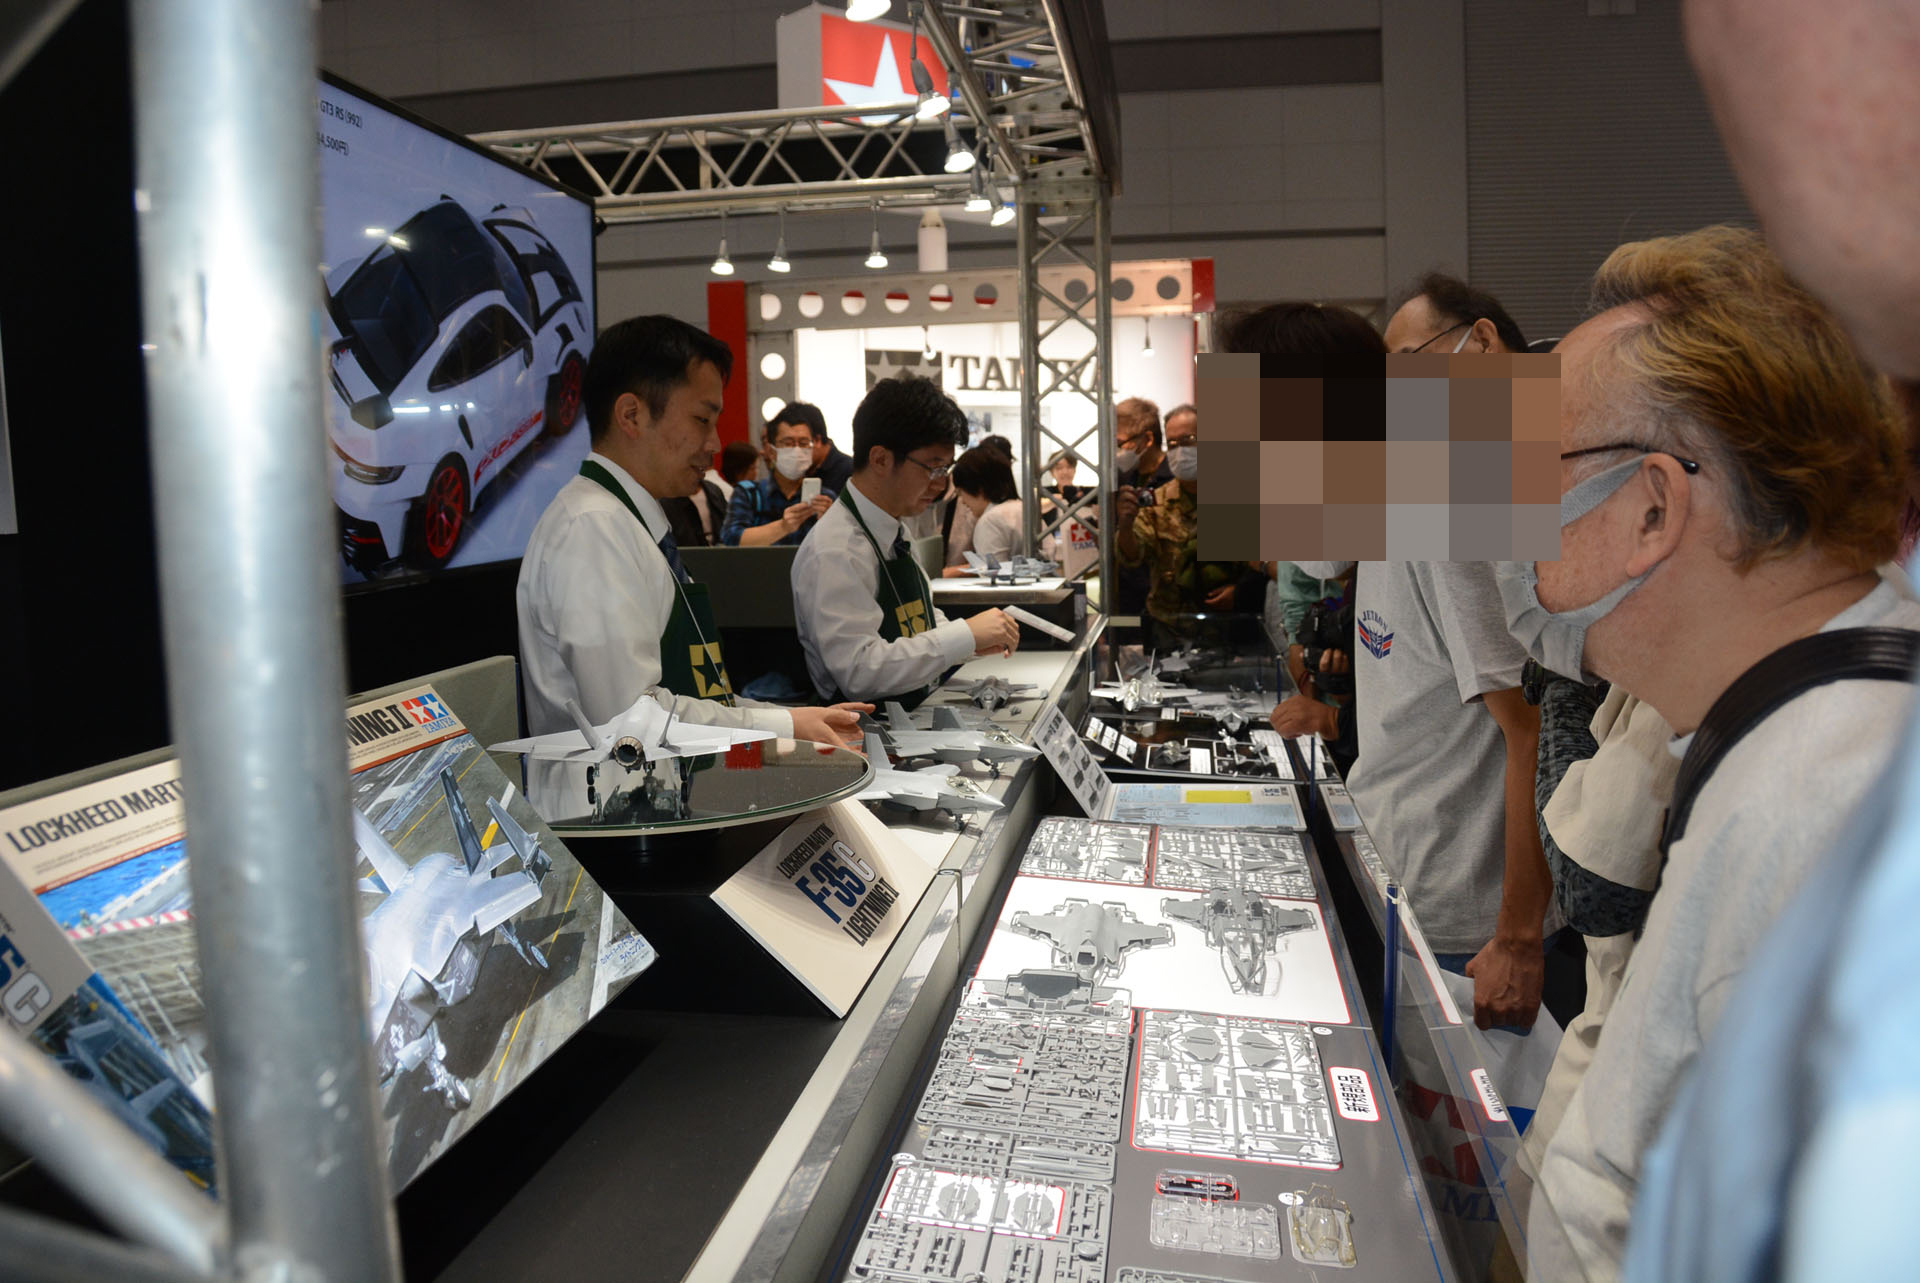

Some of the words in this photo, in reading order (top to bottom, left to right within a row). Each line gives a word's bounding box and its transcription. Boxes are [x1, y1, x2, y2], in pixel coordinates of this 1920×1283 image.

[320, 100, 334, 116] GT3
[421, 716, 457, 734] TAMIYA
[5, 799, 128, 854] LOCKHEED
[345, 709, 401, 747] NING
[776, 840, 816, 880] LOCKHEED
[804, 822, 835, 852] MARTIN
[795, 839, 877, 925] F-35C
[842, 882, 896, 947] LIGHTNING
[1337, 1074, 1371, 1114] 新規部品
